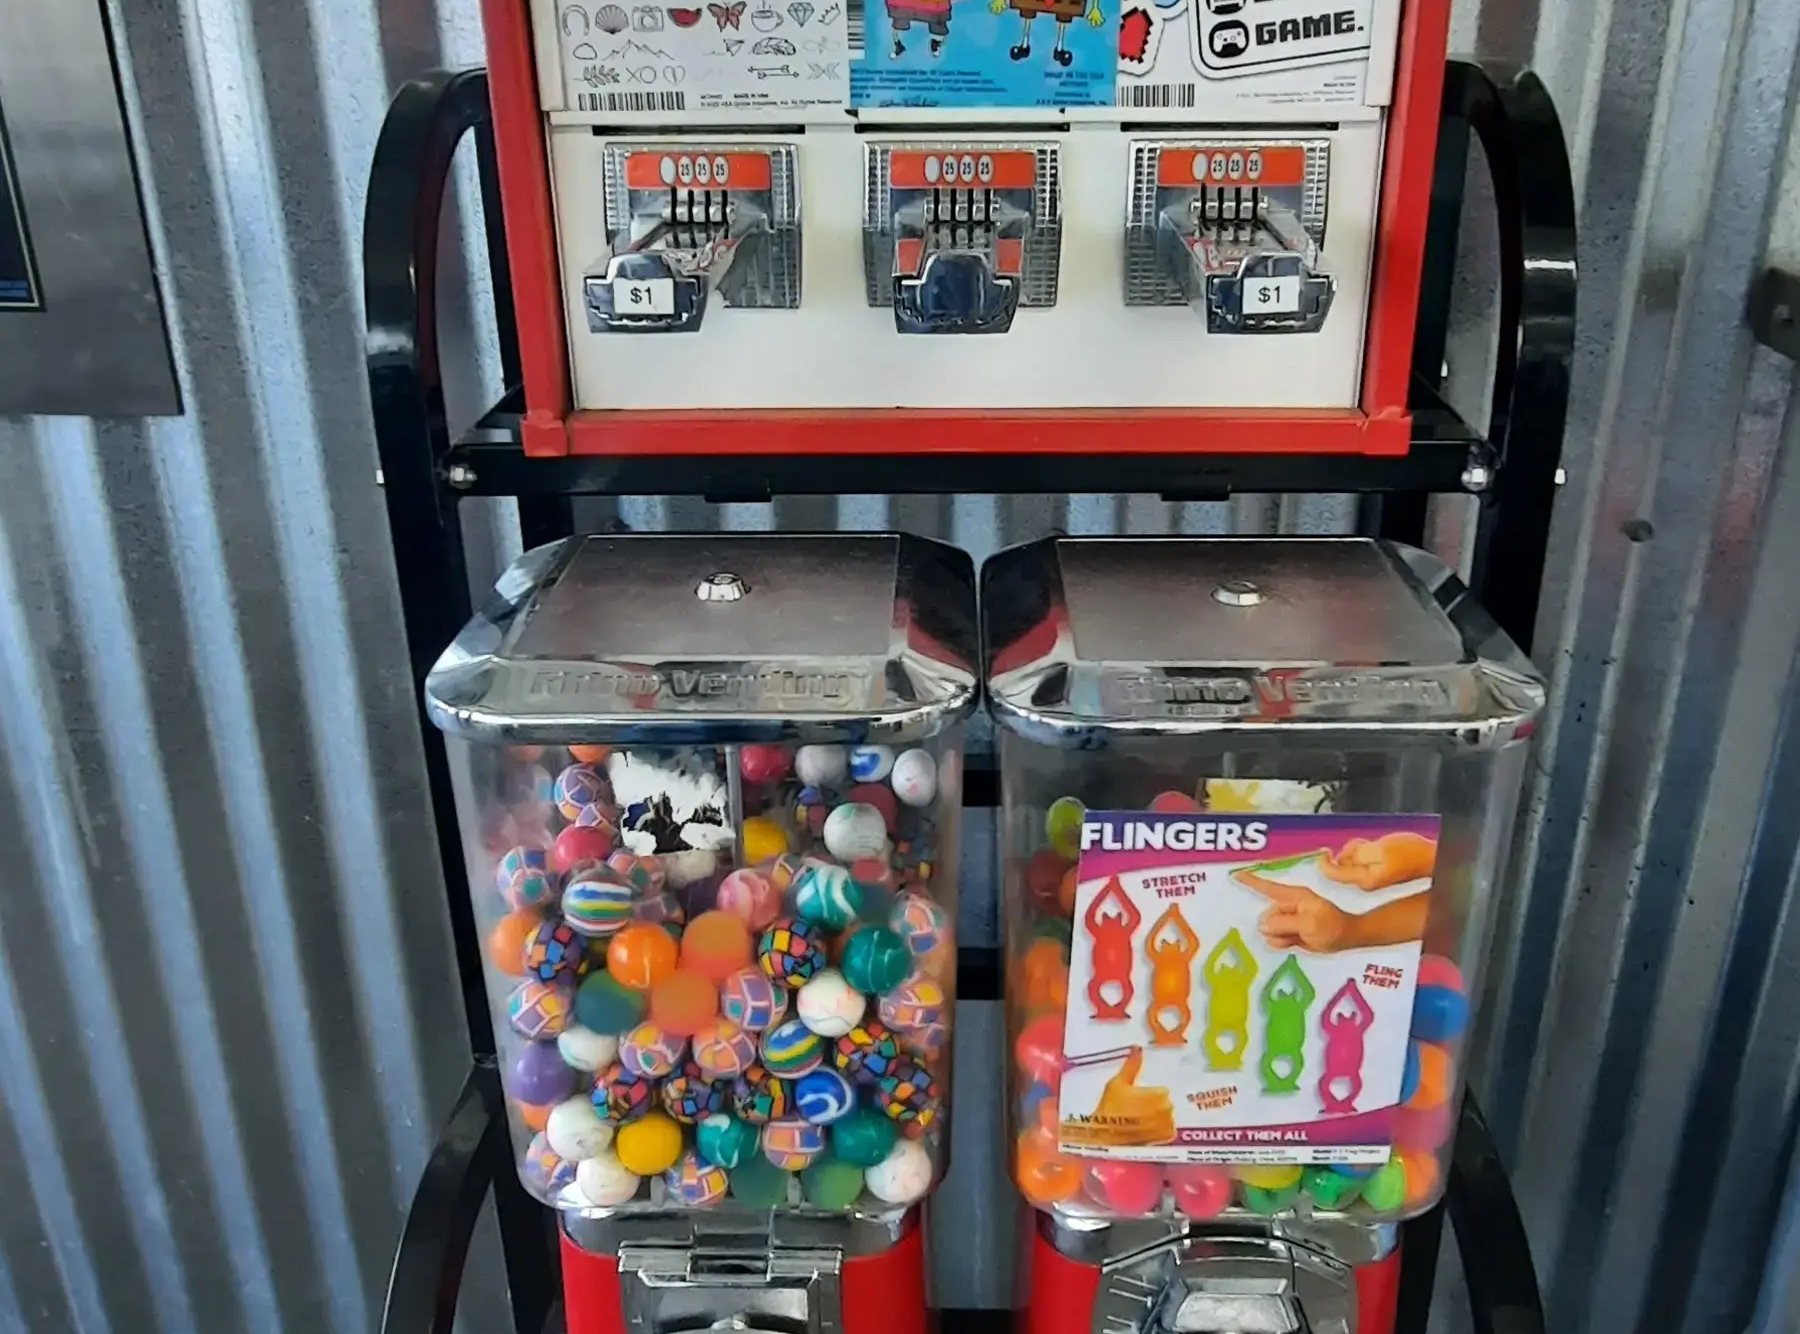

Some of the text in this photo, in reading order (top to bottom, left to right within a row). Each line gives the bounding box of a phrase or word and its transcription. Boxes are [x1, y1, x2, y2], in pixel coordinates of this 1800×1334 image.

[1255, 10, 1364, 46] GAME.
[680, 163, 726, 176] 25 25 25
[944, 162, 990, 175] 25 25 25
[1212, 160, 1258, 172] 25 25 25
[630, 287, 651, 305] $1
[1258, 285, 1280, 303] $1
[1081, 821, 1269, 852] FLINGERS
[1142, 872, 1206, 889] STRETCH
[1156, 884, 1196, 899] THEM
[1365, 963, 1403, 978] FLING
[1363, 974, 1400, 989] THEM
[1187, 1085, 1238, 1102] SQUISH
[1197, 1096, 1232, 1110] THEM
[1181, 1129, 1309, 1142] COLLECT THEM ALL
